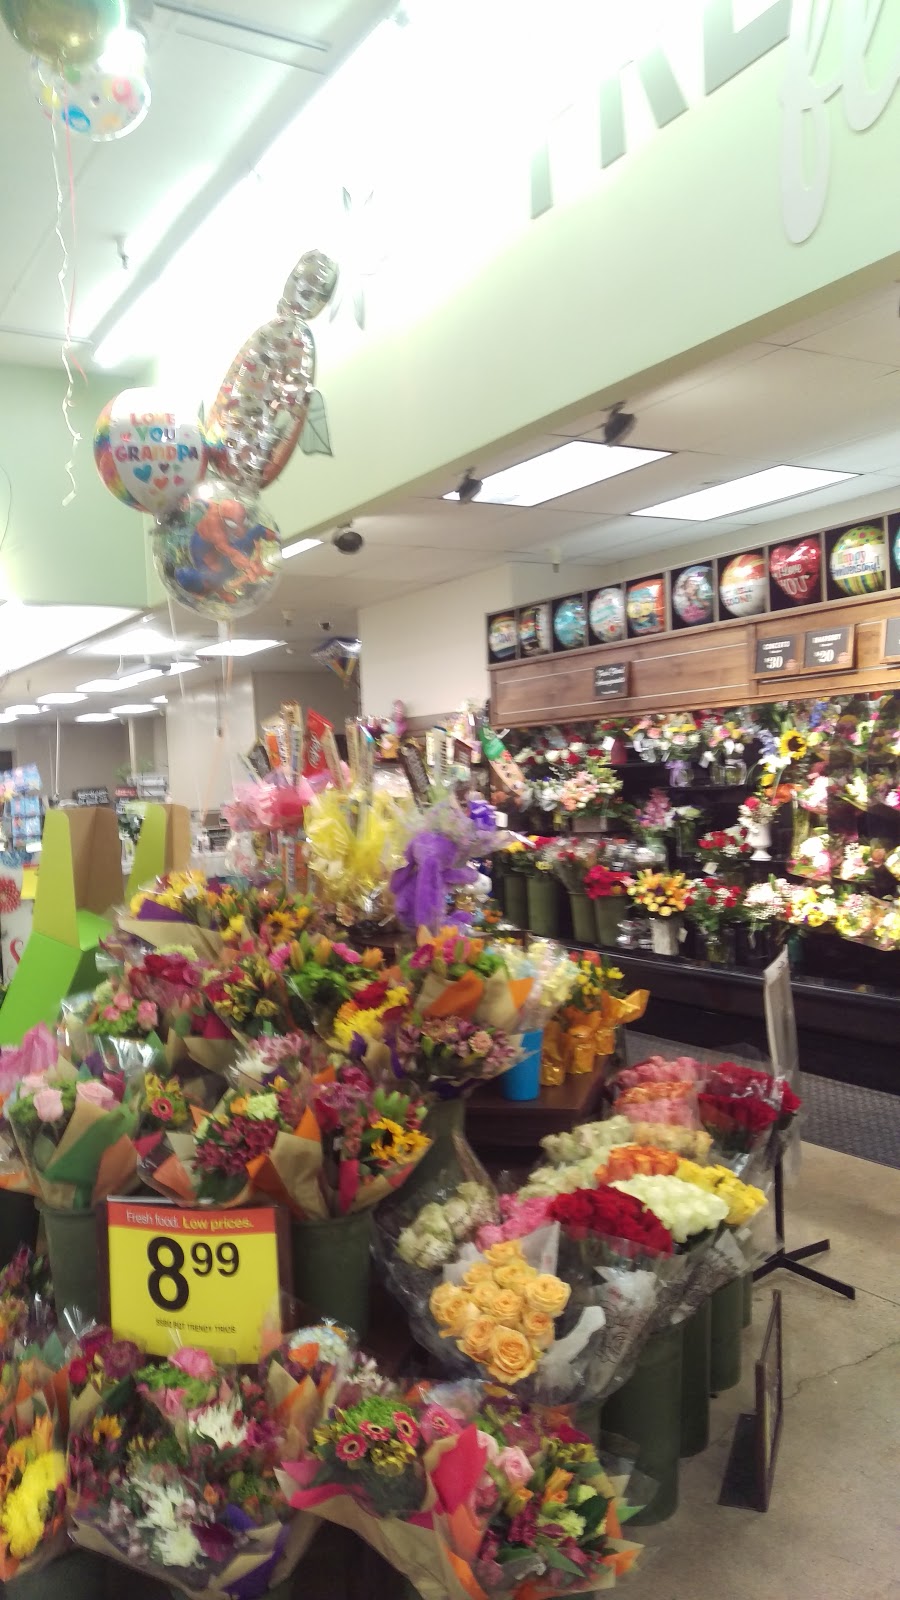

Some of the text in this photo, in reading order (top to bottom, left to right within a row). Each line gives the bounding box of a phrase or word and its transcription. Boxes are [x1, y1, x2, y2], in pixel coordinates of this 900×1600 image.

[135, 426, 176, 442] YOU
[114, 444, 199, 463] GRANDPA
[778, 574, 811, 595] YOU
[126, 1210, 254, 1232] Fresh food. Low prices.
